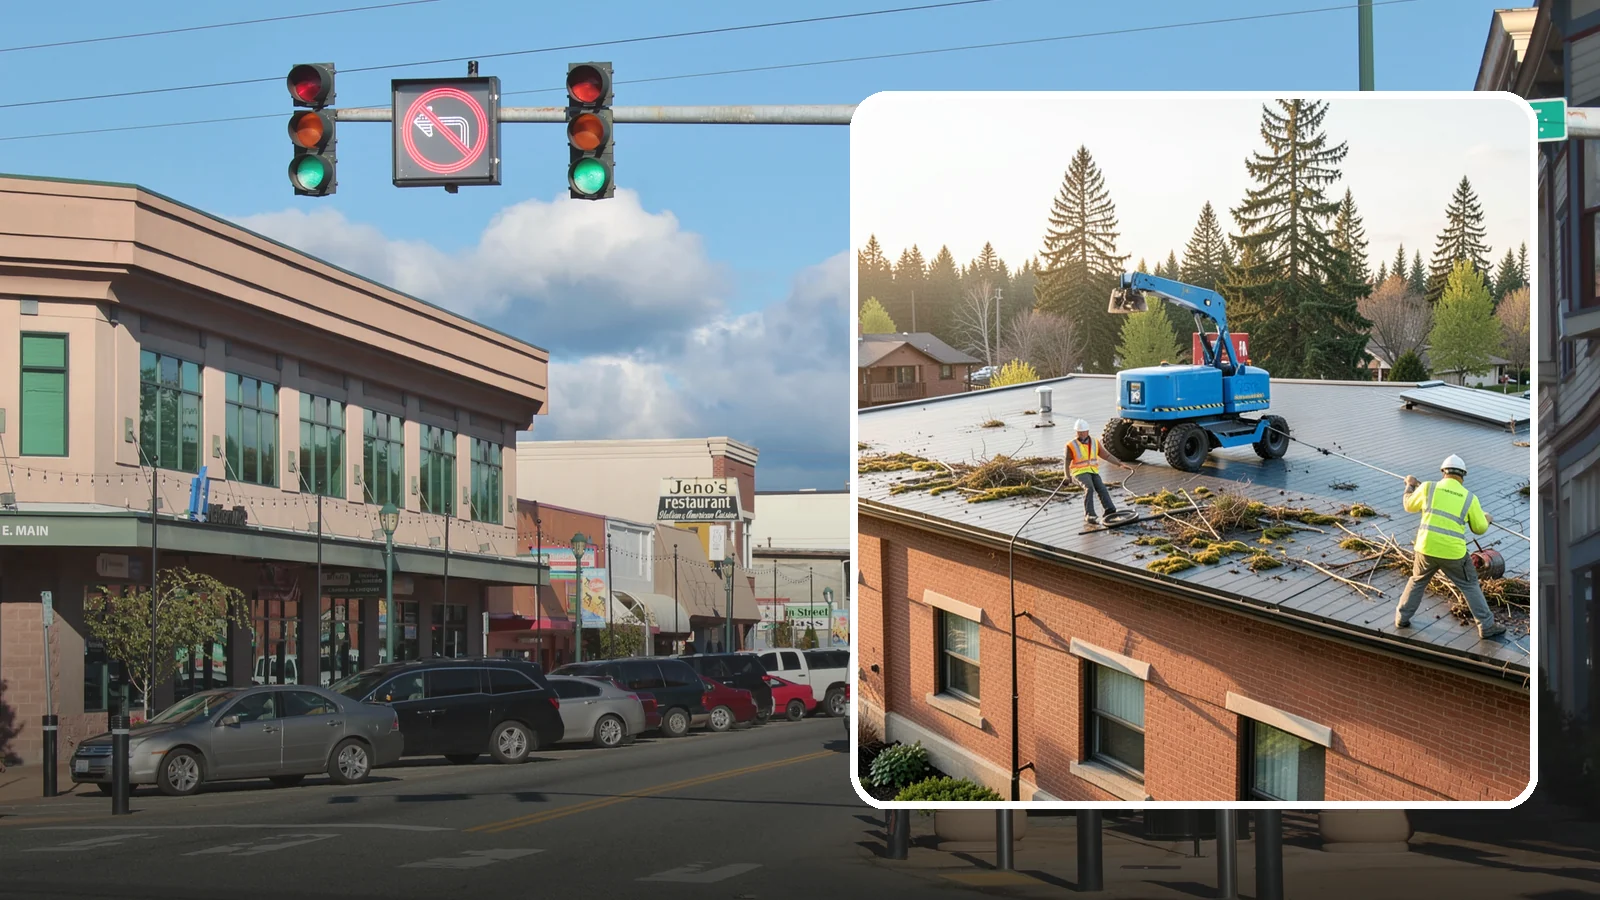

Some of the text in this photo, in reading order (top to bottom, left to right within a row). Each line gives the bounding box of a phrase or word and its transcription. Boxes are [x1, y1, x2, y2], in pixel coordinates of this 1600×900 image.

[669, 480, 727, 494] Jeno's
[665, 497, 731, 509] restaurant
[659, 510, 682, 520] Italian
[686, 510, 714, 519] American
[715, 509, 737, 520] Cuisine
[2, 525, 49, 536] E. MAIN
[797, 607, 828, 617] Street
